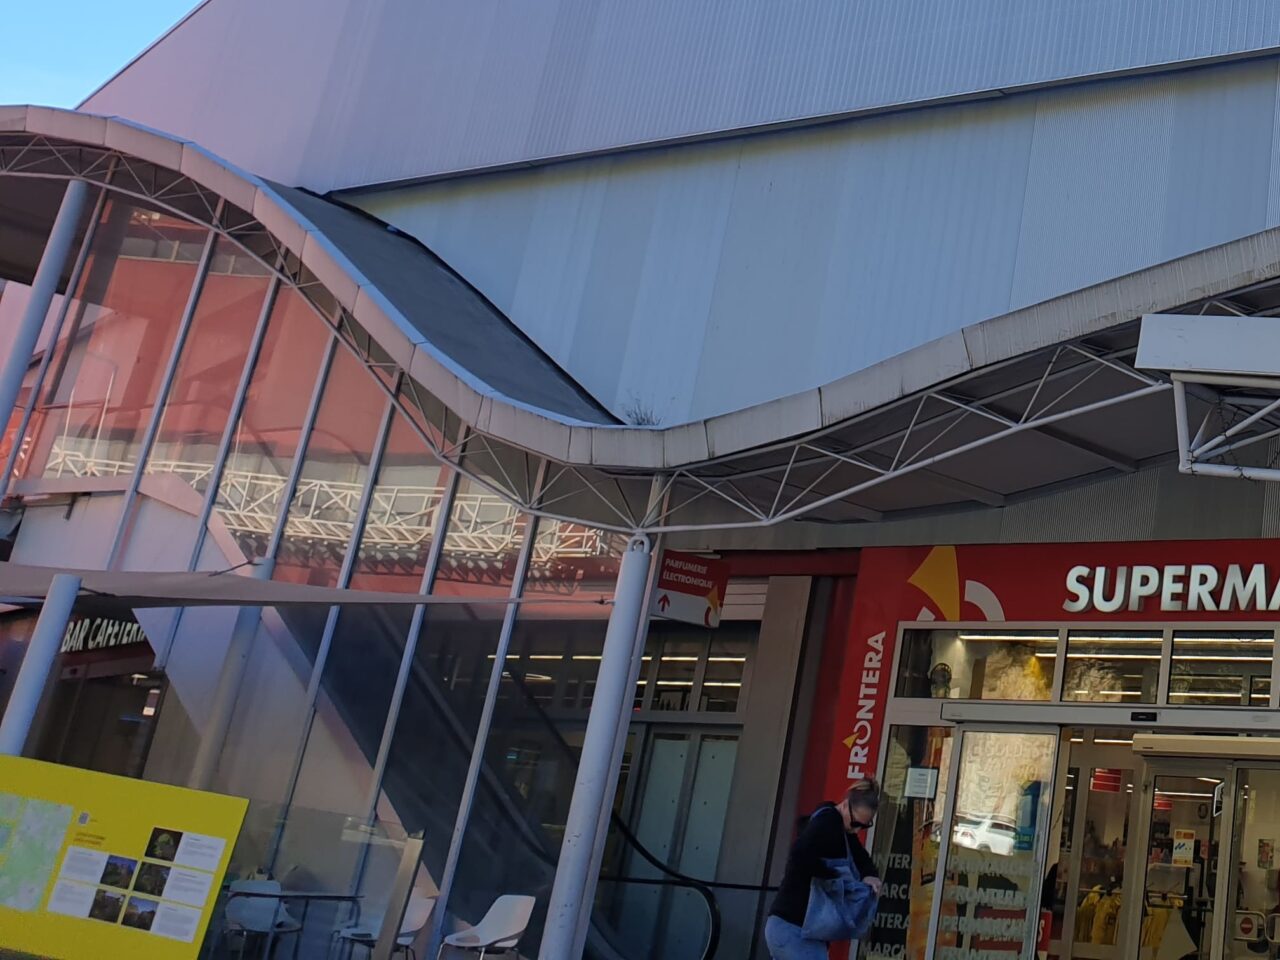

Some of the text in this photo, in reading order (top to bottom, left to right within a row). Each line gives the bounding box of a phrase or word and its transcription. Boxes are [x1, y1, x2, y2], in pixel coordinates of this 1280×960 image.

[664, 558, 708, 575] PARFUMERIE
[60, 618, 91, 653] BAR
[846, 631, 887, 780] FRONTERA
